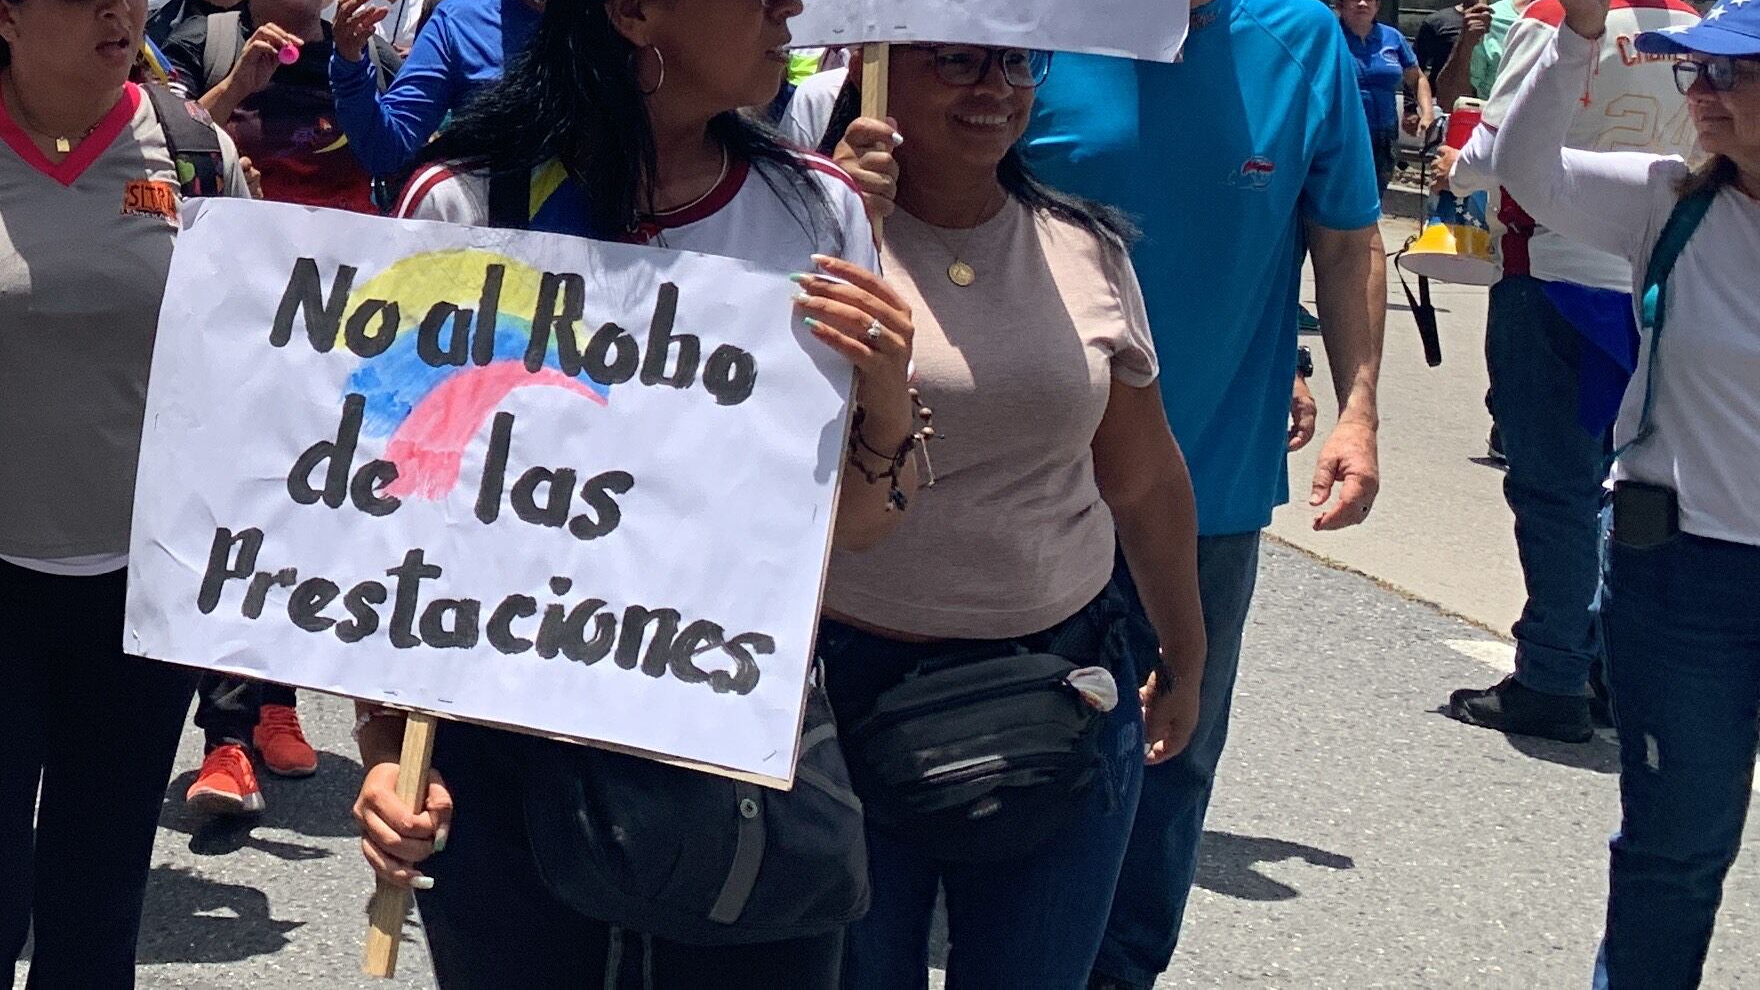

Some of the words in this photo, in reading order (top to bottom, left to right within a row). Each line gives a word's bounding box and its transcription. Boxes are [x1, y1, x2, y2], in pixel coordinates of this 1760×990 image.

[269, 257, 400, 358] No
[417, 263, 504, 367] al
[523, 270, 758, 407] Robo
[286, 394, 402, 516] de
[474, 412, 635, 541] las
[197, 525, 776, 695] Prestaciones
